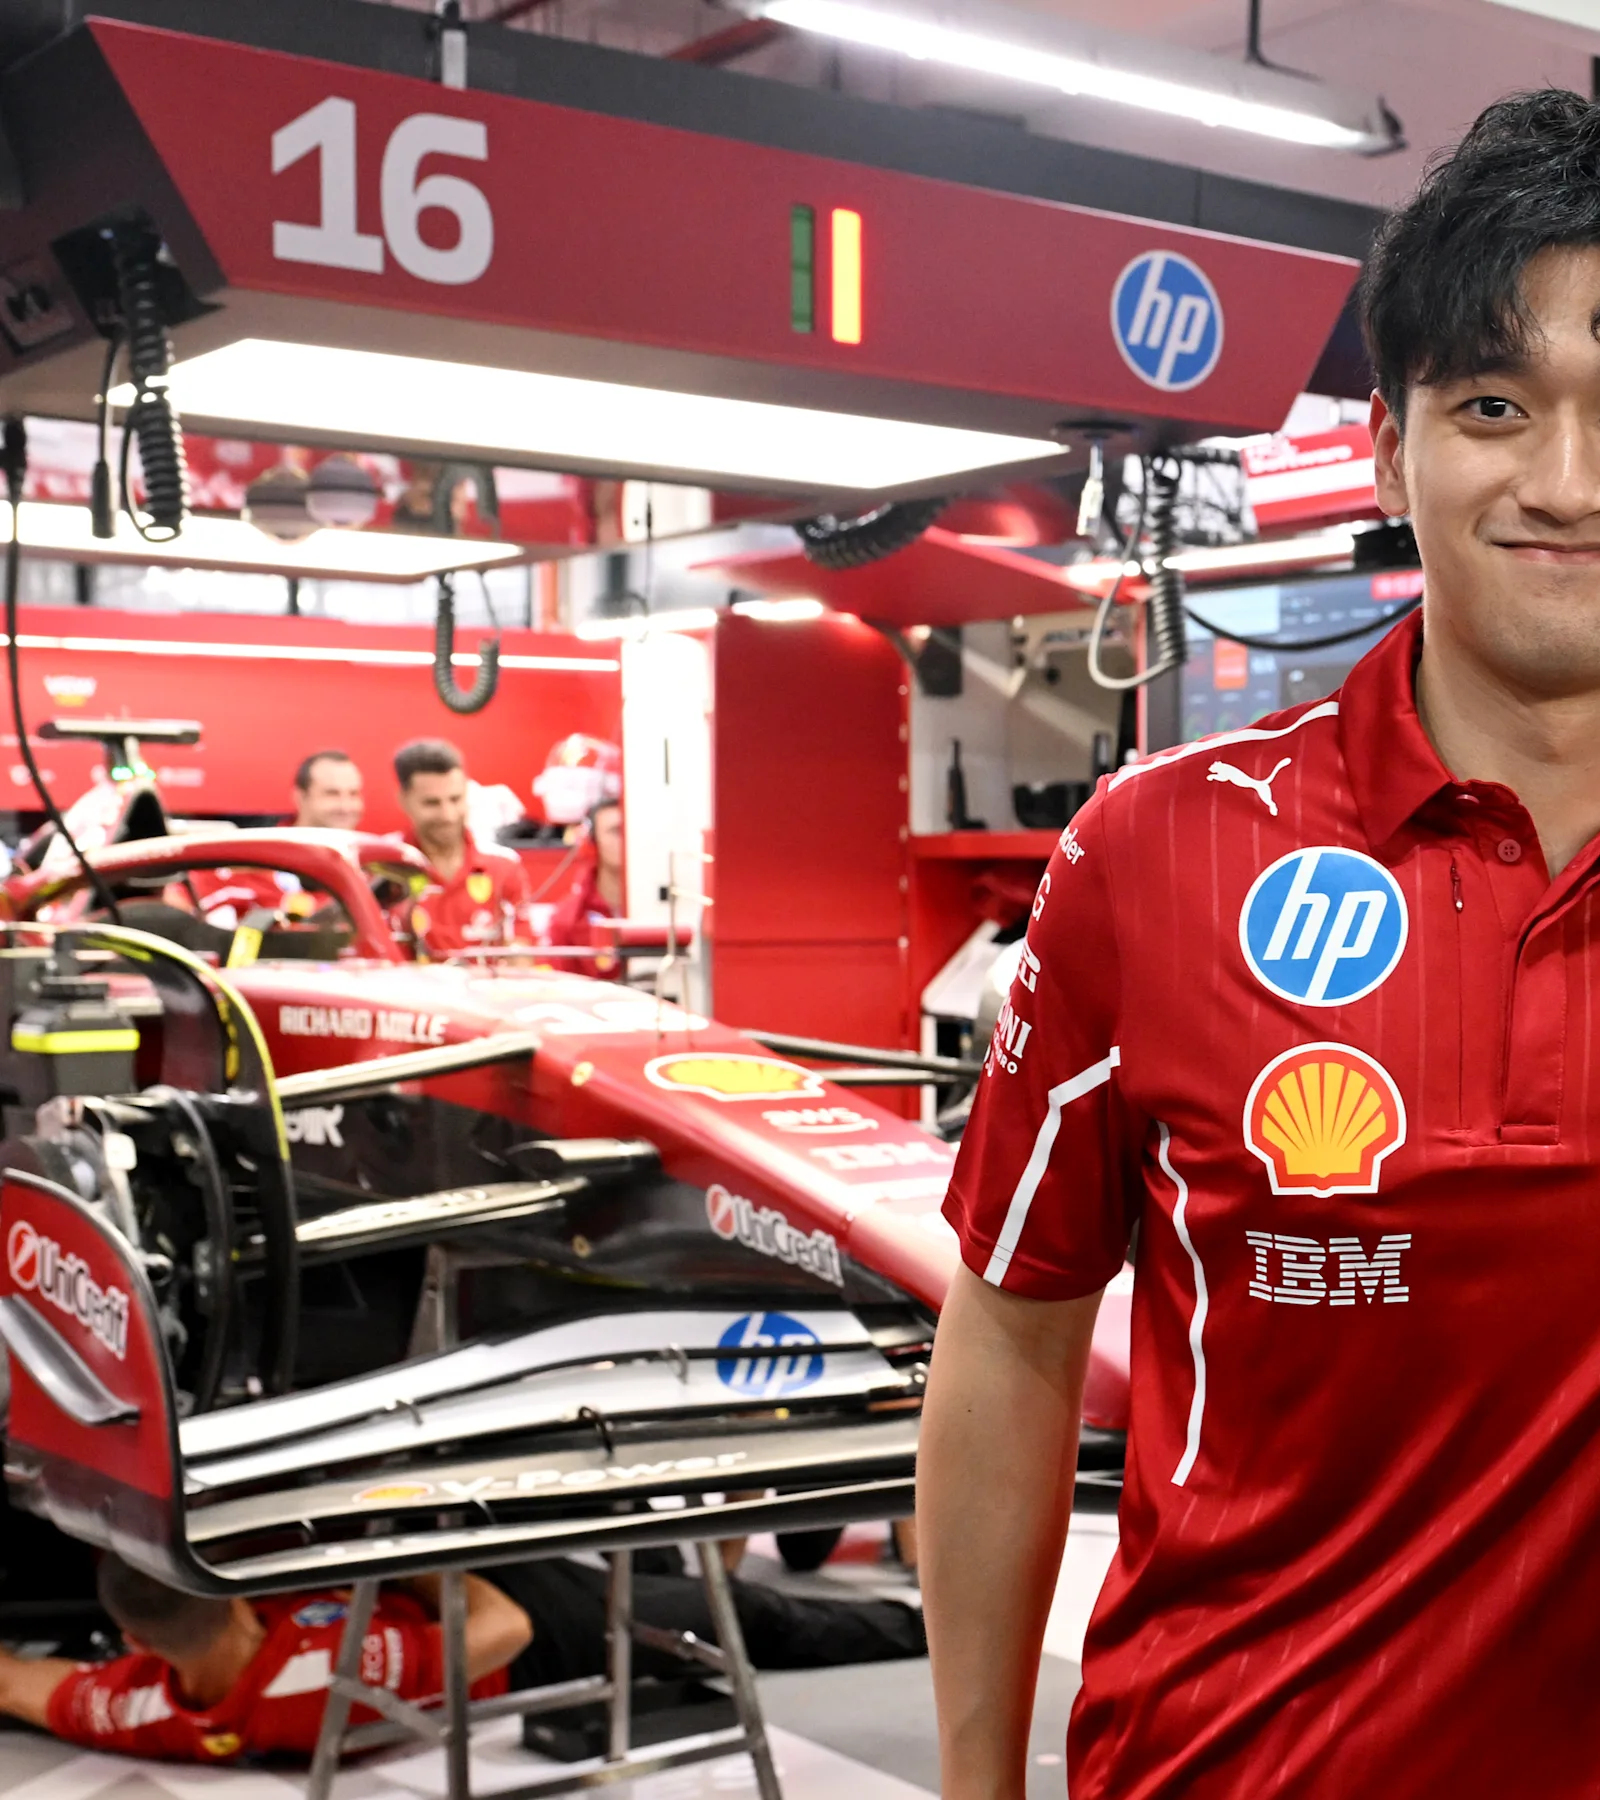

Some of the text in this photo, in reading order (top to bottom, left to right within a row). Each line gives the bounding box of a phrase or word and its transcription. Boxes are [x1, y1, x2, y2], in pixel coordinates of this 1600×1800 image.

[271, 95, 494, 286] 16
[1127, 252, 1210, 388] hp
[1263, 850, 1388, 1001] hp
[279, 1005, 450, 1045] RICHARD MILLE
[732, 1194, 845, 1288] UniCredit
[1245, 1230, 1412, 1306] IBM
[38, 1236, 130, 1362] UniCredit
[730, 1312, 816, 1397] hp
[438, 1450, 748, 1498] V-Power
